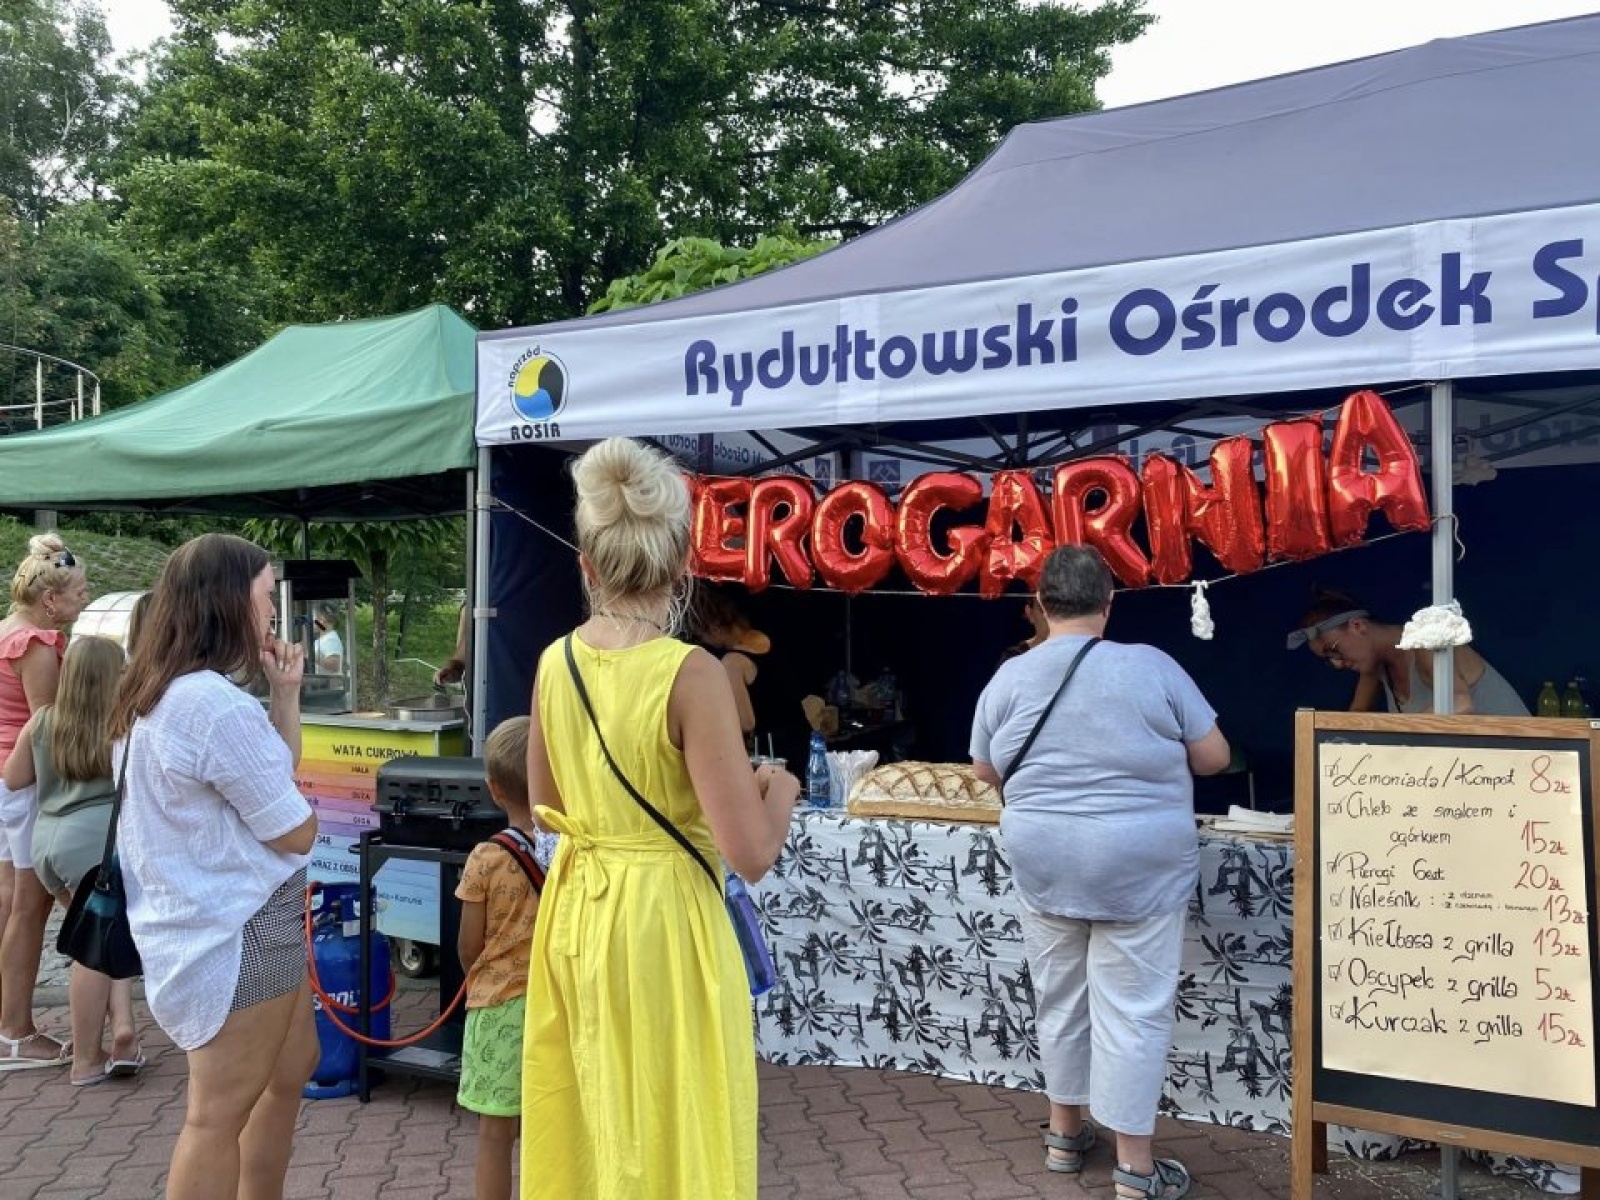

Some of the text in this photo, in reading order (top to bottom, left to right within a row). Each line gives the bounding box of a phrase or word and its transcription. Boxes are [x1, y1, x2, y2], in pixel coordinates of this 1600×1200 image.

[685, 238, 1600, 407] Rydułtowski Ośrodek S
[508, 345, 541, 387] naprzód
[511, 423, 560, 440] ROSIR
[691, 389, 1432, 599] EROGARNIA
[332, 744, 362, 757] WATA
[1347, 791, 1392, 818] Chleb
[1433, 802, 1493, 819] smalcem
[1508, 804, 1517, 818] i
[1386, 826, 1451, 857] ogórkiem
[1348, 916, 1433, 949] Kiełbasa
[1452, 933, 1514, 963] grilla
[1348, 957, 1434, 999] Oscypek
[1461, 976, 1518, 1004] grilla
[1345, 996, 1447, 1033] Kurczak
[1474, 1014, 1523, 1044] grilla
